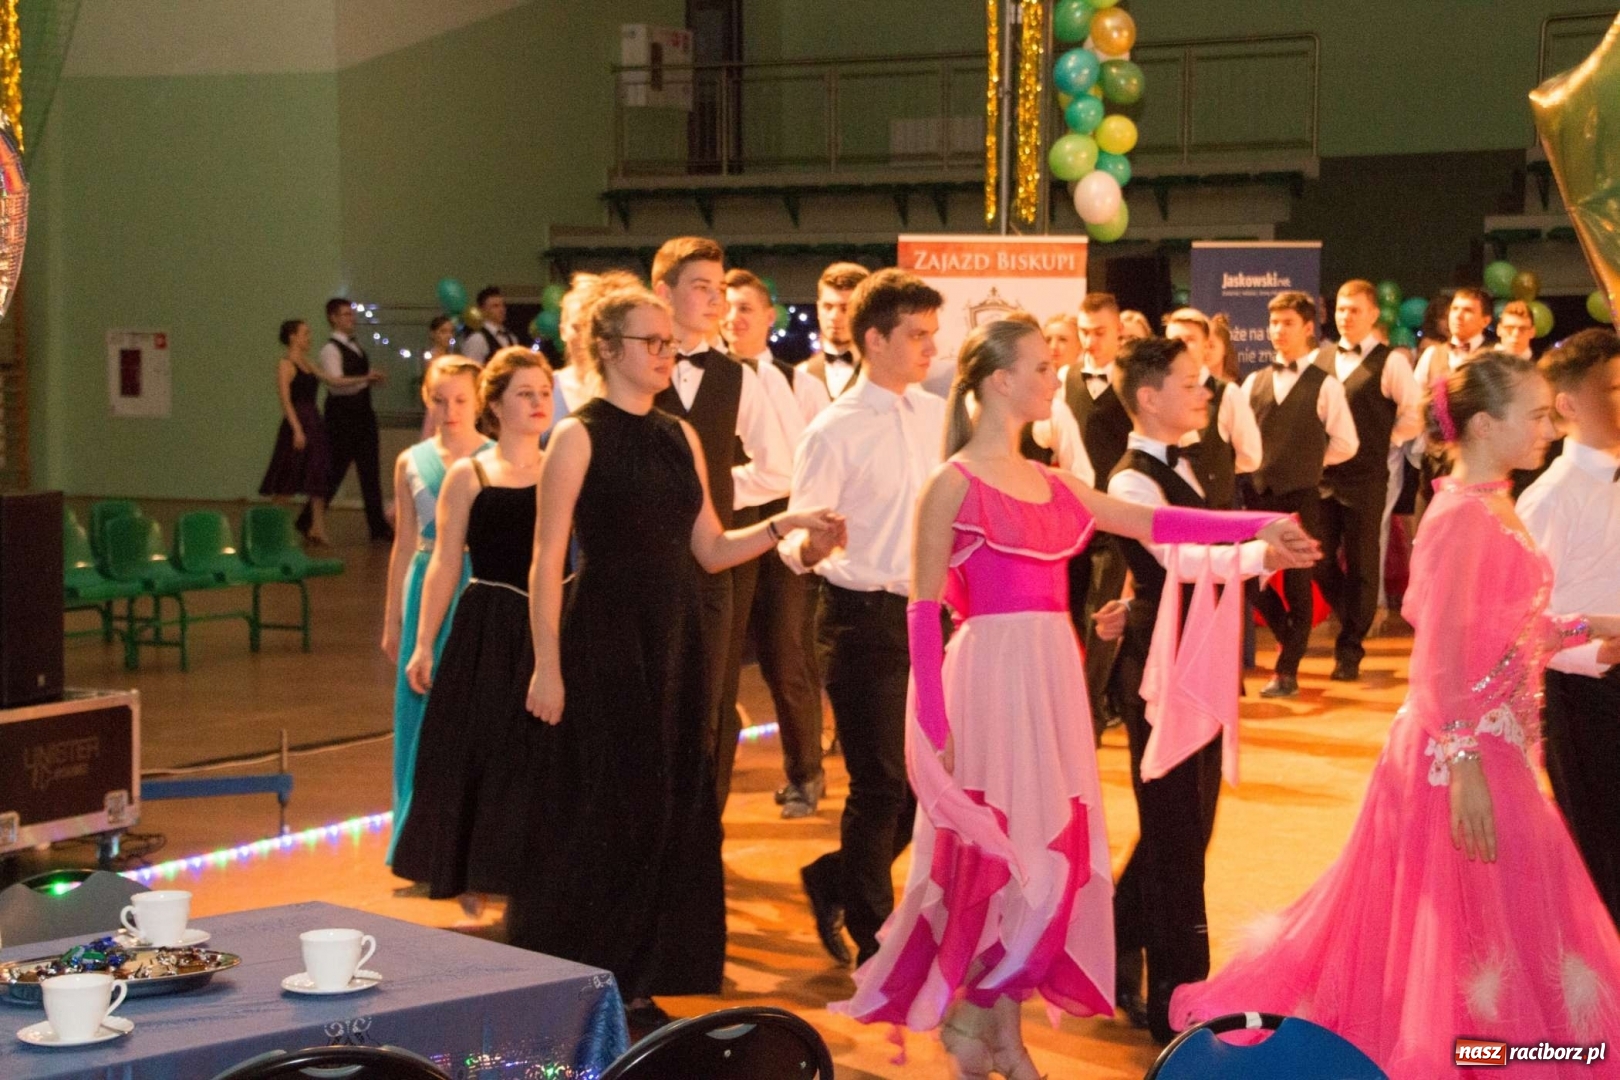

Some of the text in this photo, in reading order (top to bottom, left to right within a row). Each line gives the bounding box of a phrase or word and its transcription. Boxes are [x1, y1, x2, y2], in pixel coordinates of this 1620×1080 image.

[914, 251, 1076, 273] ZAJAZD BISKUPI
[1249, 329, 1264, 342] na
